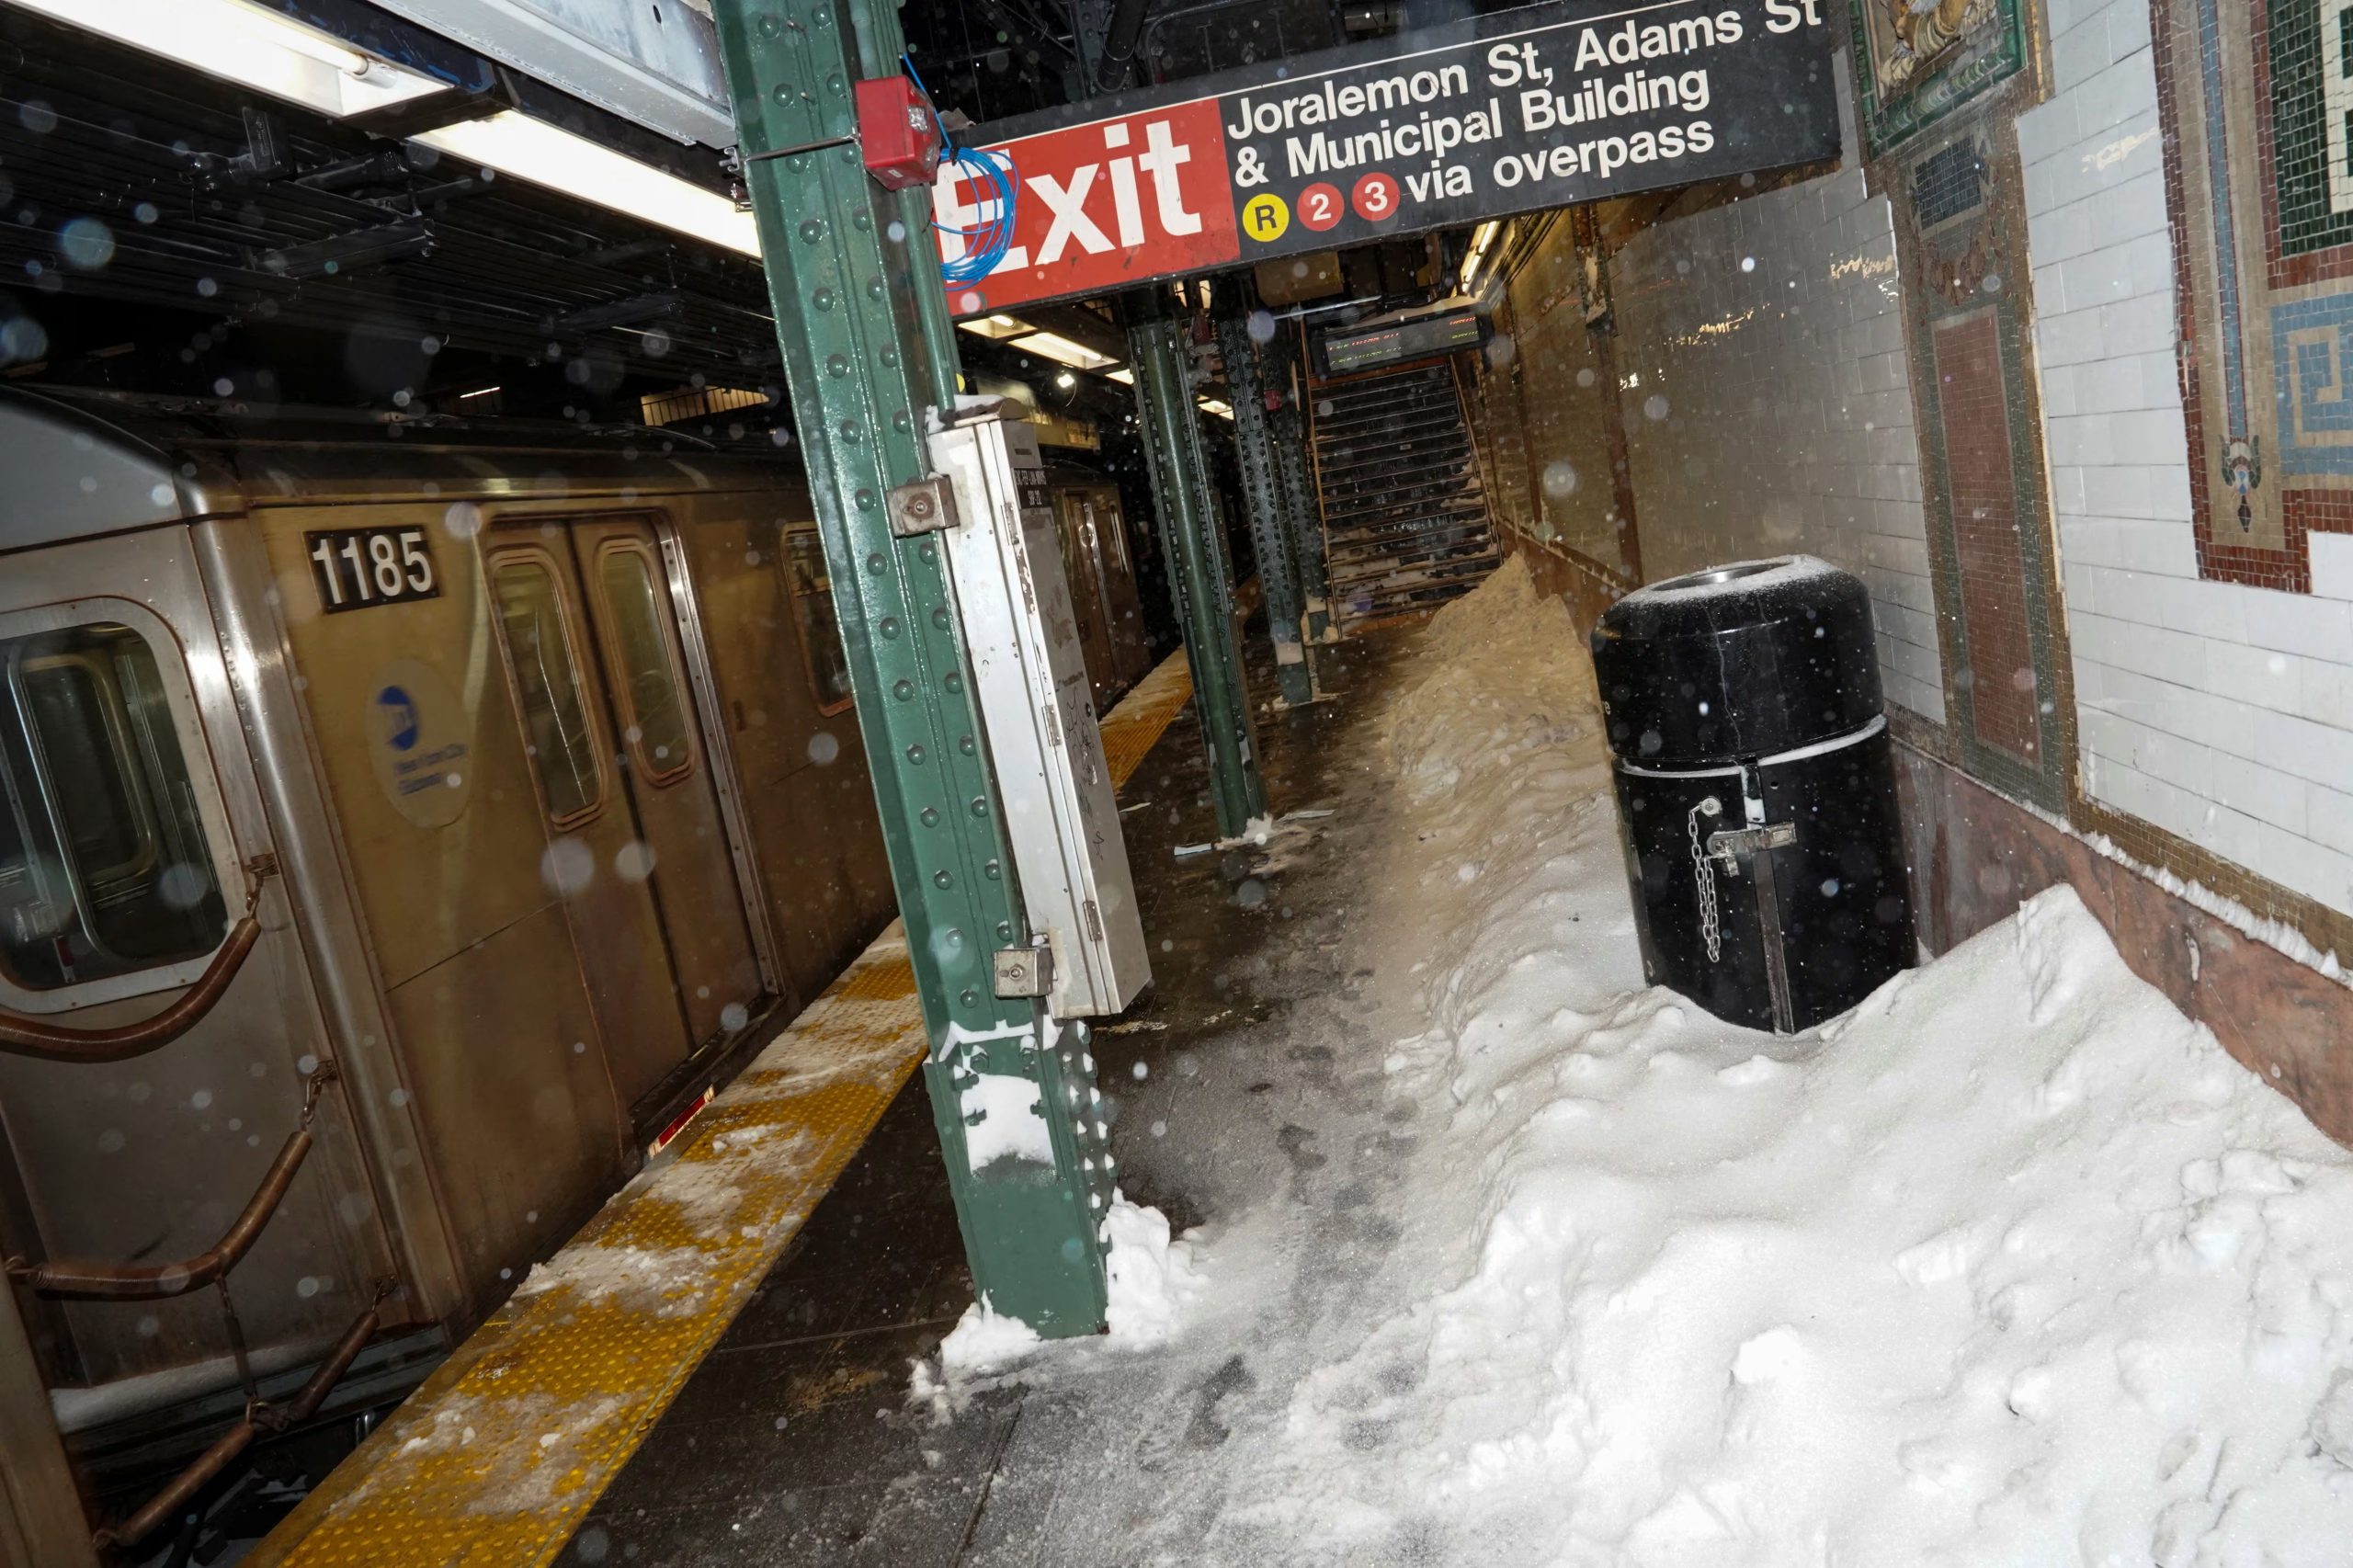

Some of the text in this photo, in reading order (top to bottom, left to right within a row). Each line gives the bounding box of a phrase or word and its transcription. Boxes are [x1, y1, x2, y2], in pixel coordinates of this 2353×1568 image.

[1228, 0, 1822, 140] Joralemon St, Adams St
[1235, 69, 1710, 187] & Municipal Building
[931, 119, 1202, 284] Exit
[1255, 120, 1715, 232] R 2 3 via overpass
[313, 531, 432, 604] 1185
